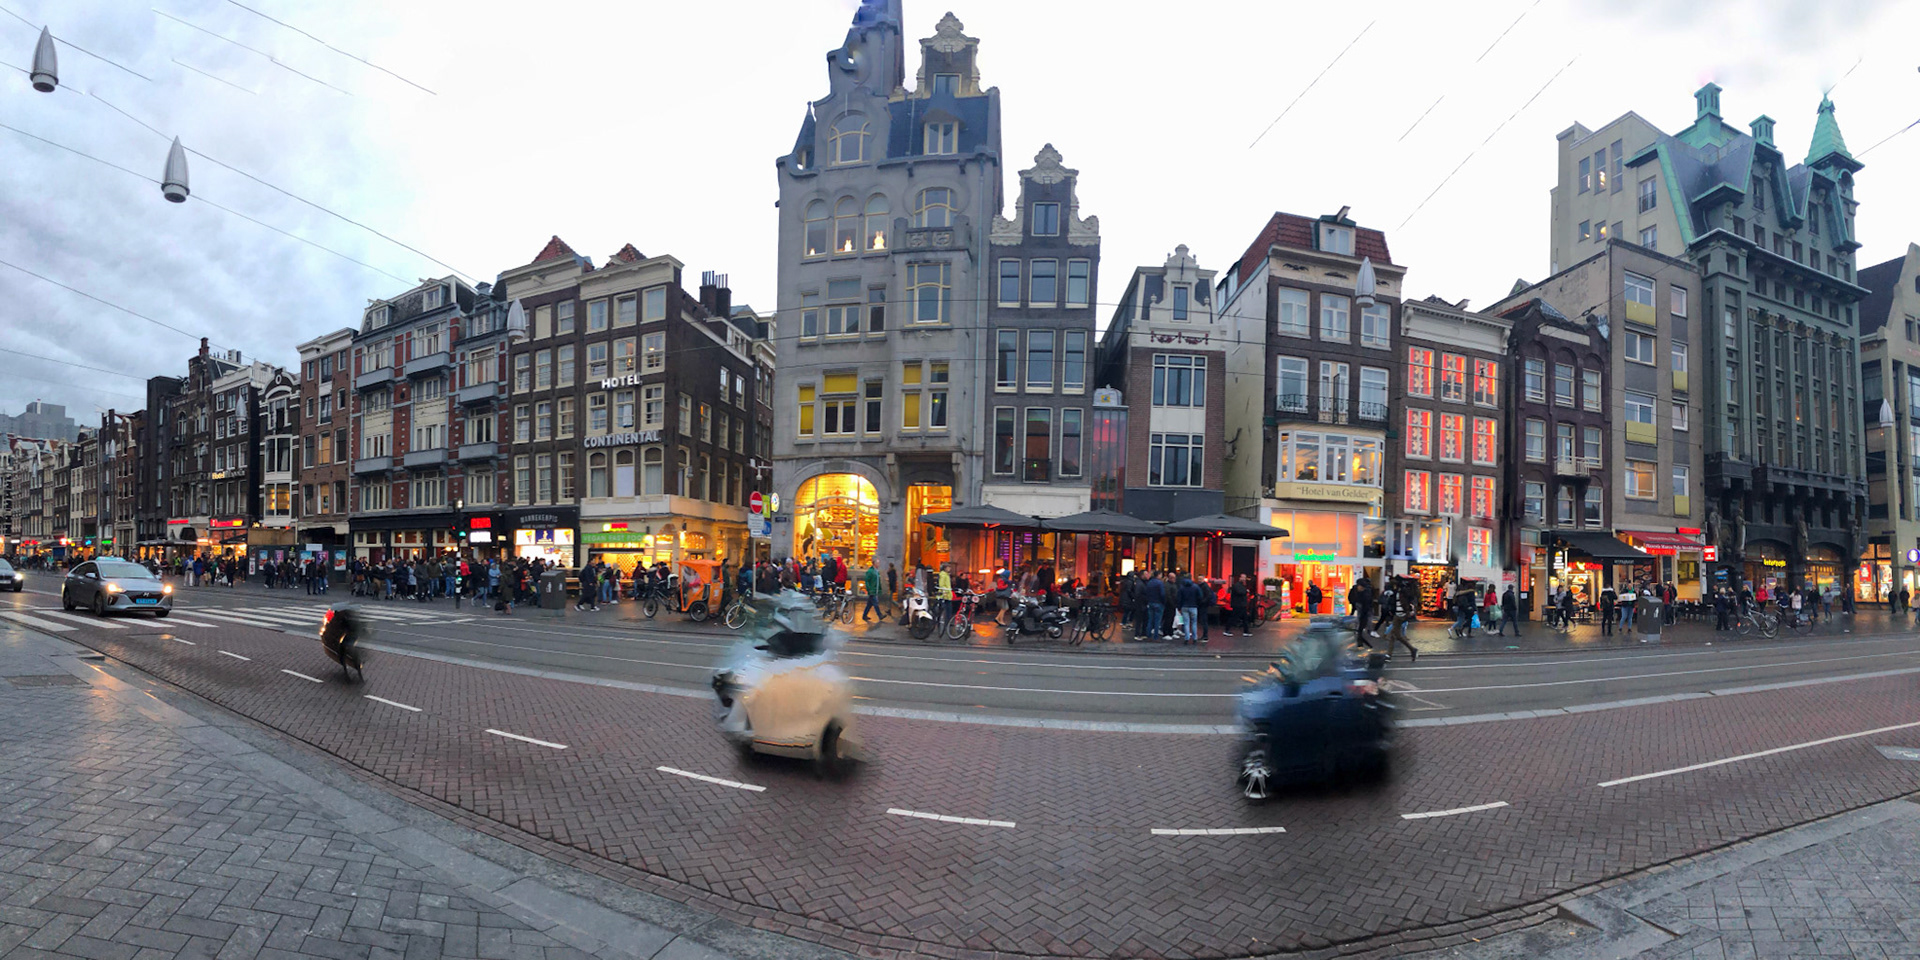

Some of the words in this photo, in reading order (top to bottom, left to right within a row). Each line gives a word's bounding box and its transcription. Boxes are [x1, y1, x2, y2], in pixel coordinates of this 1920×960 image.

[601, 374, 640, 389] HOTEL
[584, 431, 660, 448] CONTINENTAL
[1326, 489, 1341, 497] van
[1763, 558, 1786, 567] Intertoys
